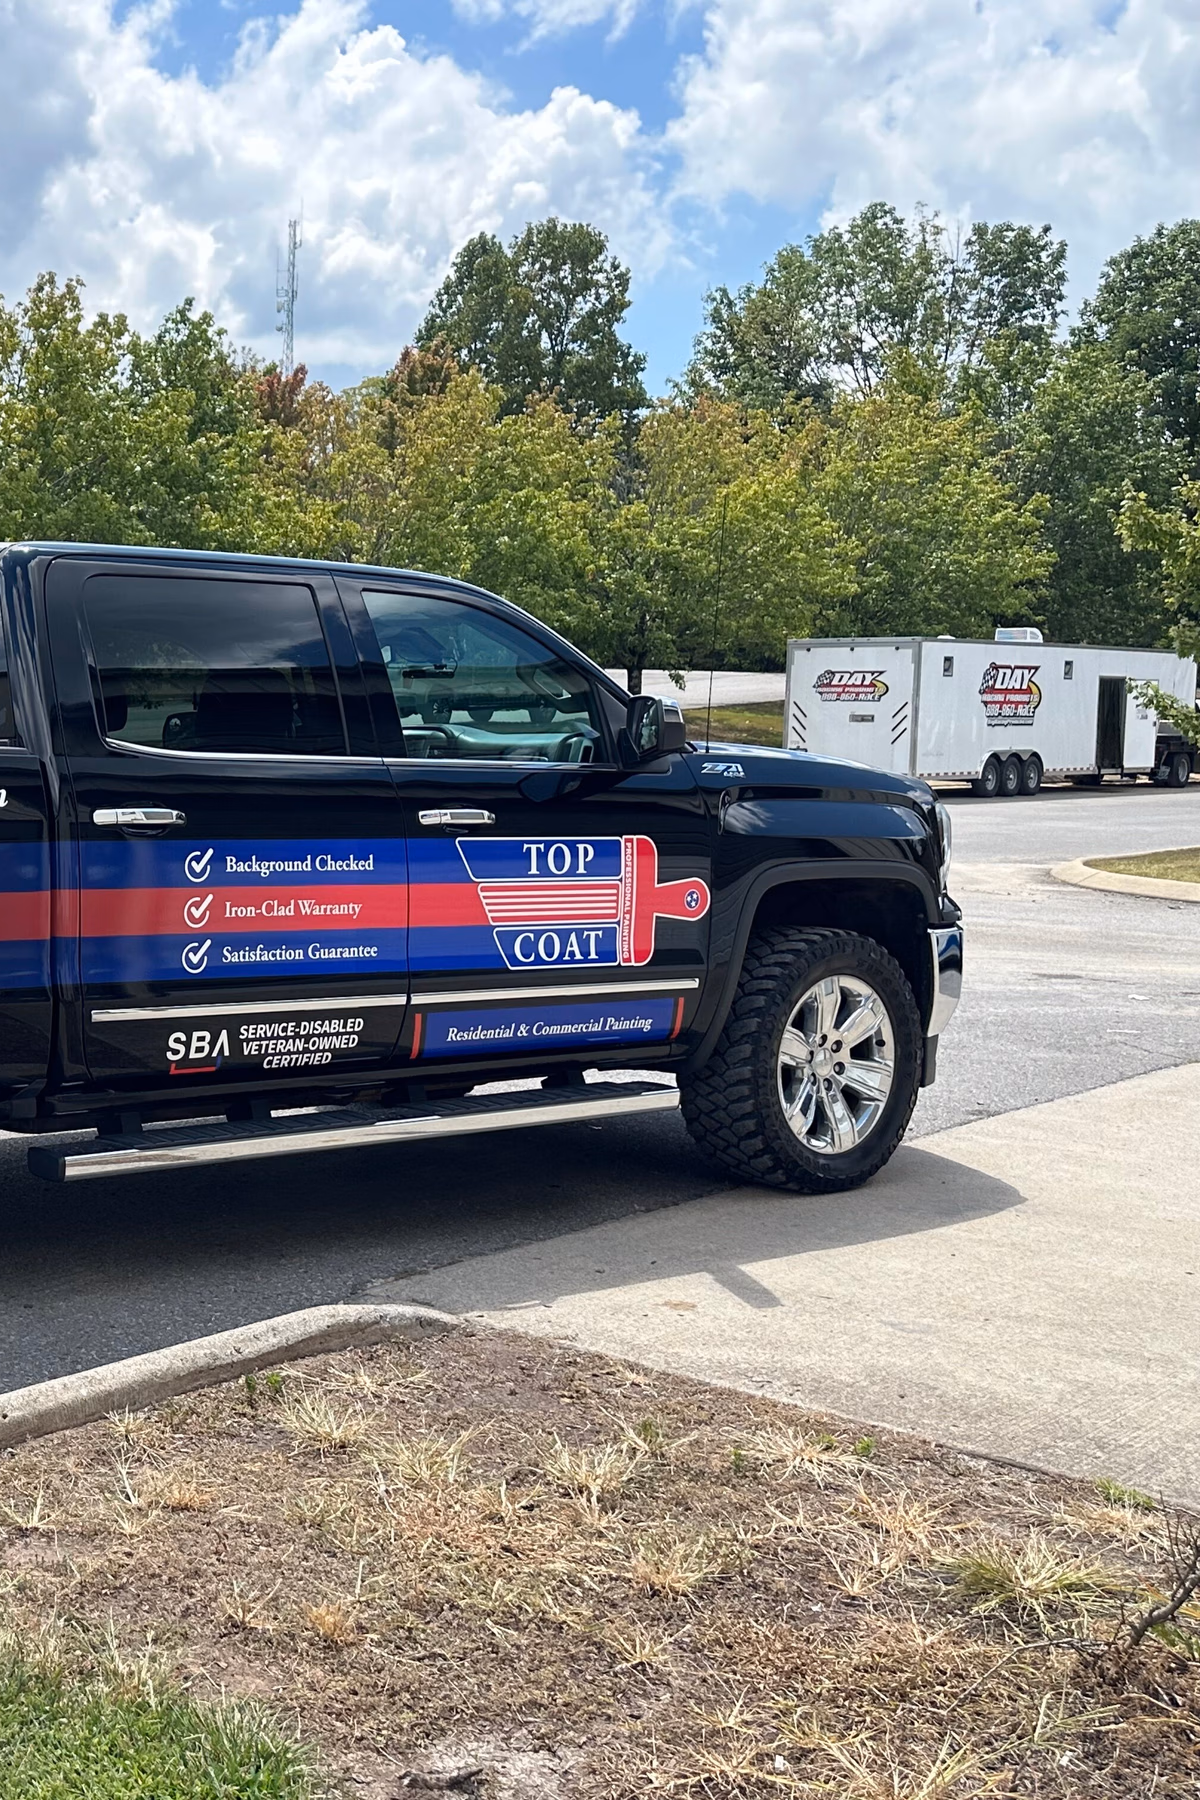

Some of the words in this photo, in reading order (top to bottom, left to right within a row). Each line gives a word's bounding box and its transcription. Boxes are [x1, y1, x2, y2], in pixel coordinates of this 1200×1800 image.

[831, 672, 881, 685] DAY
[994, 668, 1038, 689] DAY
[225, 855, 312, 877] Background
[315, 854, 374, 872] Checked
[523, 843, 595, 875] TOP
[623, 842, 632, 913] PROFESSIONAL
[224, 900, 294, 917] Iron-Clad
[298, 900, 362, 919] Warranty
[513, 930, 603, 963] COAT
[622, 913, 631, 959] PAINTING
[222, 946, 304, 963] Satisfaction
[308, 943, 378, 959] Guarantee
[239, 1018, 364, 1039] SERVICE-DISABLED
[445, 1021, 515, 1042] Residential
[516, 1023, 529, 1036] &
[532, 1017, 603, 1035] Commercial
[604, 1015, 653, 1033] Painting
[166, 1029, 230, 1061] SBA
[242, 1034, 358, 1056] VETERAN-OWNED
[262, 1051, 332, 1069] CERTIFIED
